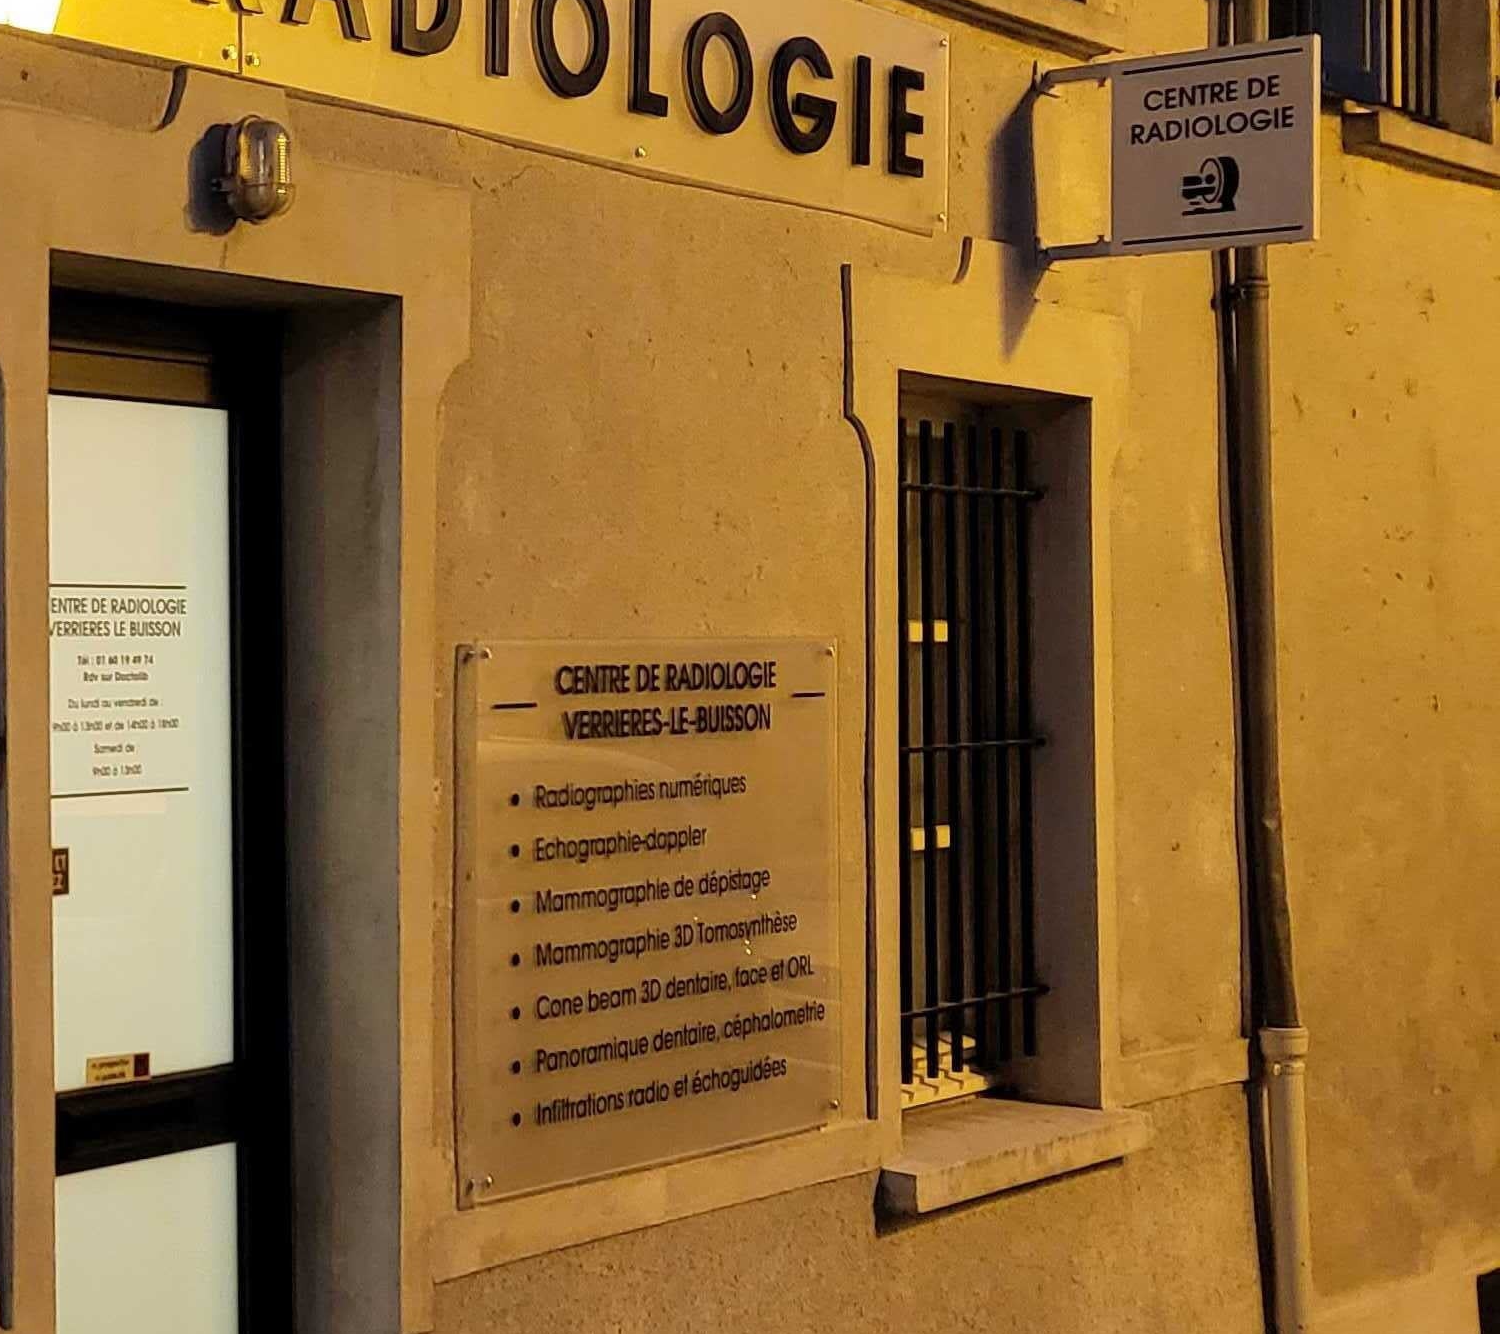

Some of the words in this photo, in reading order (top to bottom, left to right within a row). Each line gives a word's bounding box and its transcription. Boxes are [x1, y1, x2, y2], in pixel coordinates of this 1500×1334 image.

[1143, 79, 1238, 112] CENTRE
[1247, 74, 1280, 100] DE
[1130, 105, 1295, 145] RADIOLOGIE
[50, 597, 88, 614] ENTRE
[91, 597, 108, 614] DE
[110, 598, 187, 615] RADIOLOGIE
[113, 621, 126, 636] LE
[129, 621, 181, 636] BUISSON
[555, 664, 630, 695] CENTRE
[635, 664, 661, 693] DE
[665, 661, 777, 691] RADIOLOGIE
[561, 703, 771, 739] VERRIERES-LE-BUISSON
[535, 779, 655, 811] Radiographies
[659, 772, 747, 799] numériques
[535, 826, 707, 863] Echographie-doppler
[535, 880, 669, 914] Mammographie
[674, 875, 694, 898] de
[699, 868, 771, 896] dépistage
[535, 931, 669, 966] Mammographie
[674, 924, 694, 948] 3D
[697, 910, 797, 943] Tomosynthèse
[535, 990, 584, 1020] Cone
[588, 986, 636, 1012] beam
[641, 978, 662, 1003] 3D
[666, 969, 731, 999] dentaire,
[735, 963, 767, 988] face
[771, 959, 784, 979] et
[788, 955, 814, 978] ORL
[535, 1034, 648, 1073] Panoramique
[653, 1021, 720, 1052] dentaire,
[535, 1090, 625, 1126] Infiltrations
[628, 1080, 669, 1107] radio
[674, 1074, 688, 1098] et
[692, 1056, 787, 1095] échoguidées
